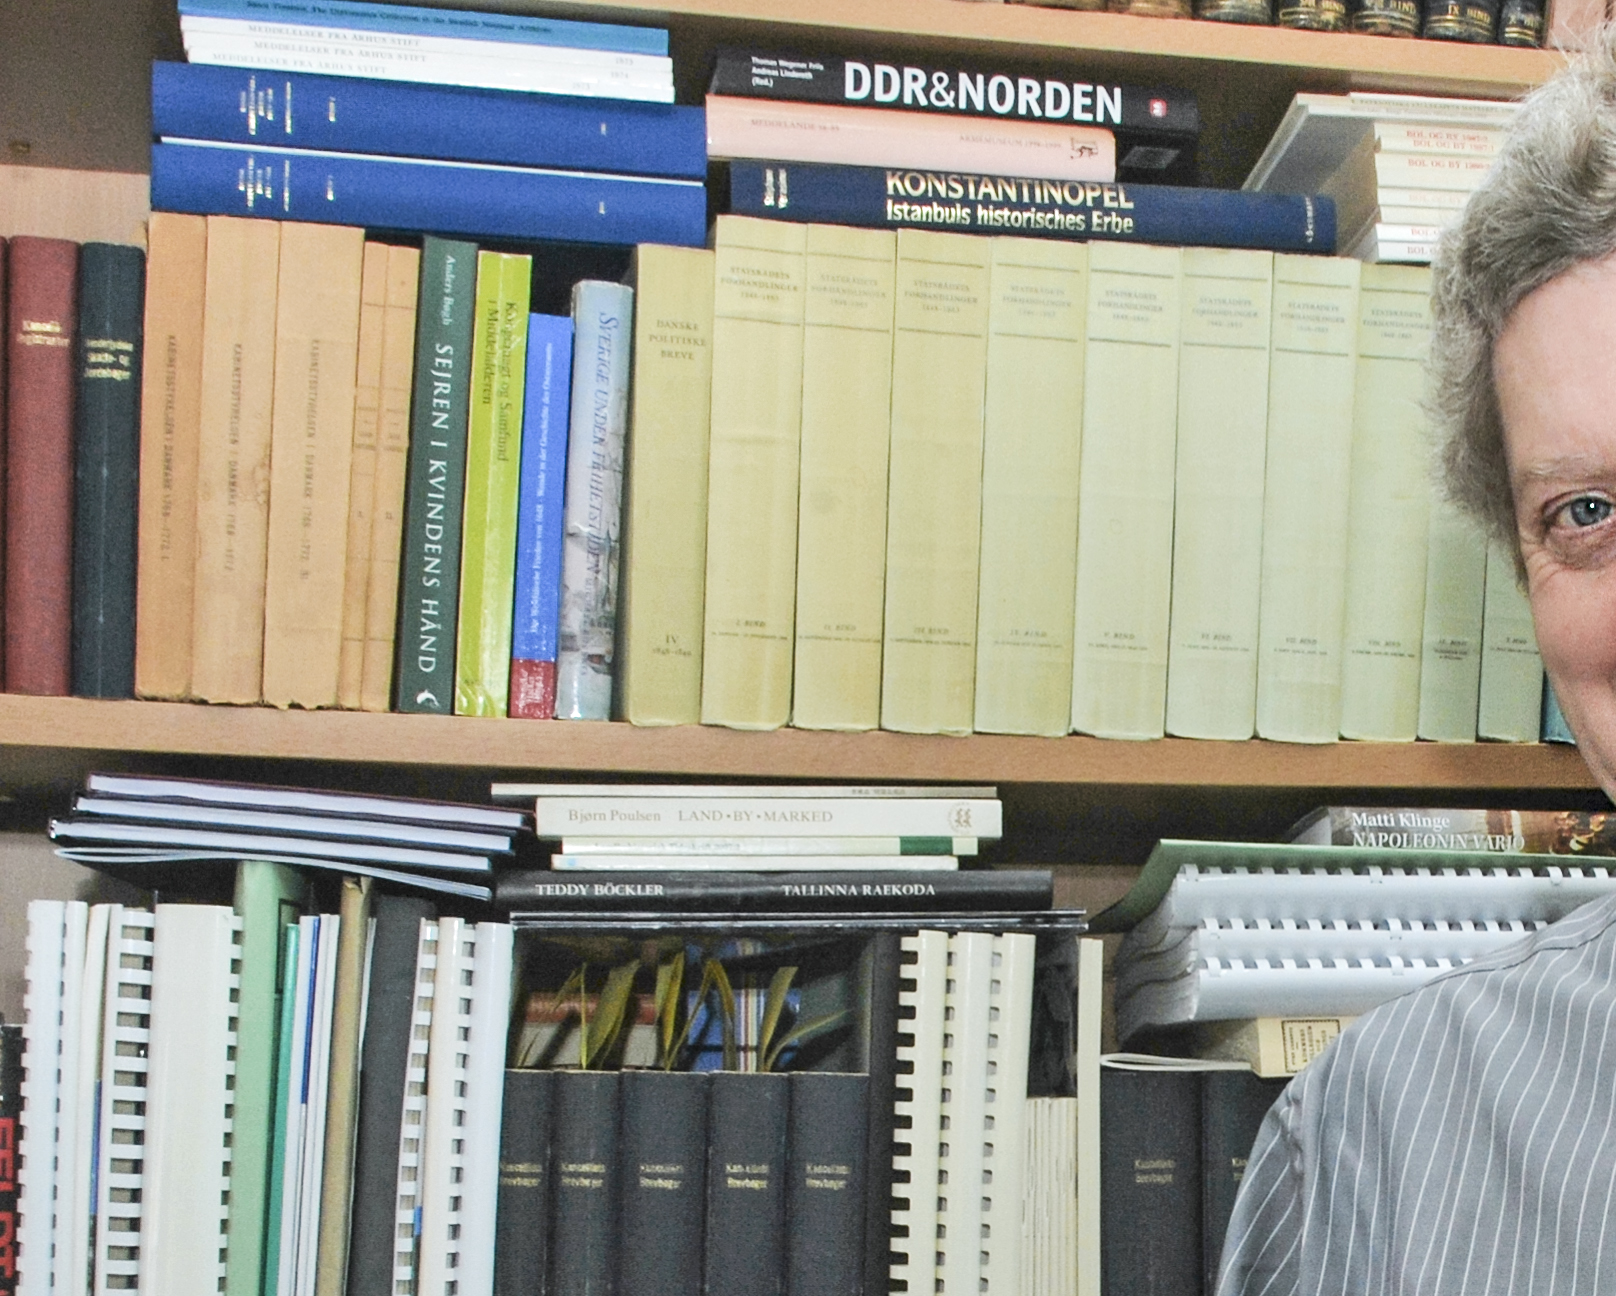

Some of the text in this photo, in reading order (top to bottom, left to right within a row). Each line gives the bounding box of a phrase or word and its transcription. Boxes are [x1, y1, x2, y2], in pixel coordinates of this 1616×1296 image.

[844, 60, 1123, 124] DDR&NORDEN
[885, 170, 1135, 211] KONSTANTINOPEL
[885, 199, 1135, 235] Istanbuls historisches Erbe
[1407, 247, 1428, 255] BOL
[444, 254, 456, 294] Anders
[594, 311, 620, 391] SVERIGE
[496, 383, 510, 400] og
[496, 402, 513, 462] Samfund
[540, 407, 550, 448] Geschichte
[592, 391, 610, 446] UNDER
[537, 472, 546, 498] Wende
[417, 343, 454, 673] SEJREN I KVINDENS HÅND
[535, 504, 545, 523] 1648
[535, 525, 544, 539] von
[533, 540, 544, 569] Frieden
[567, 809, 608, 824] Bjørn
[610, 809, 662, 822] Poulsen
[1352, 811, 1451, 832] Matti Klinge
[1351, 830, 1468, 850] NAPOLEONIN
[536, 881, 936, 897] TEDDY BÖCKLER TALLINNA RAEKODA
